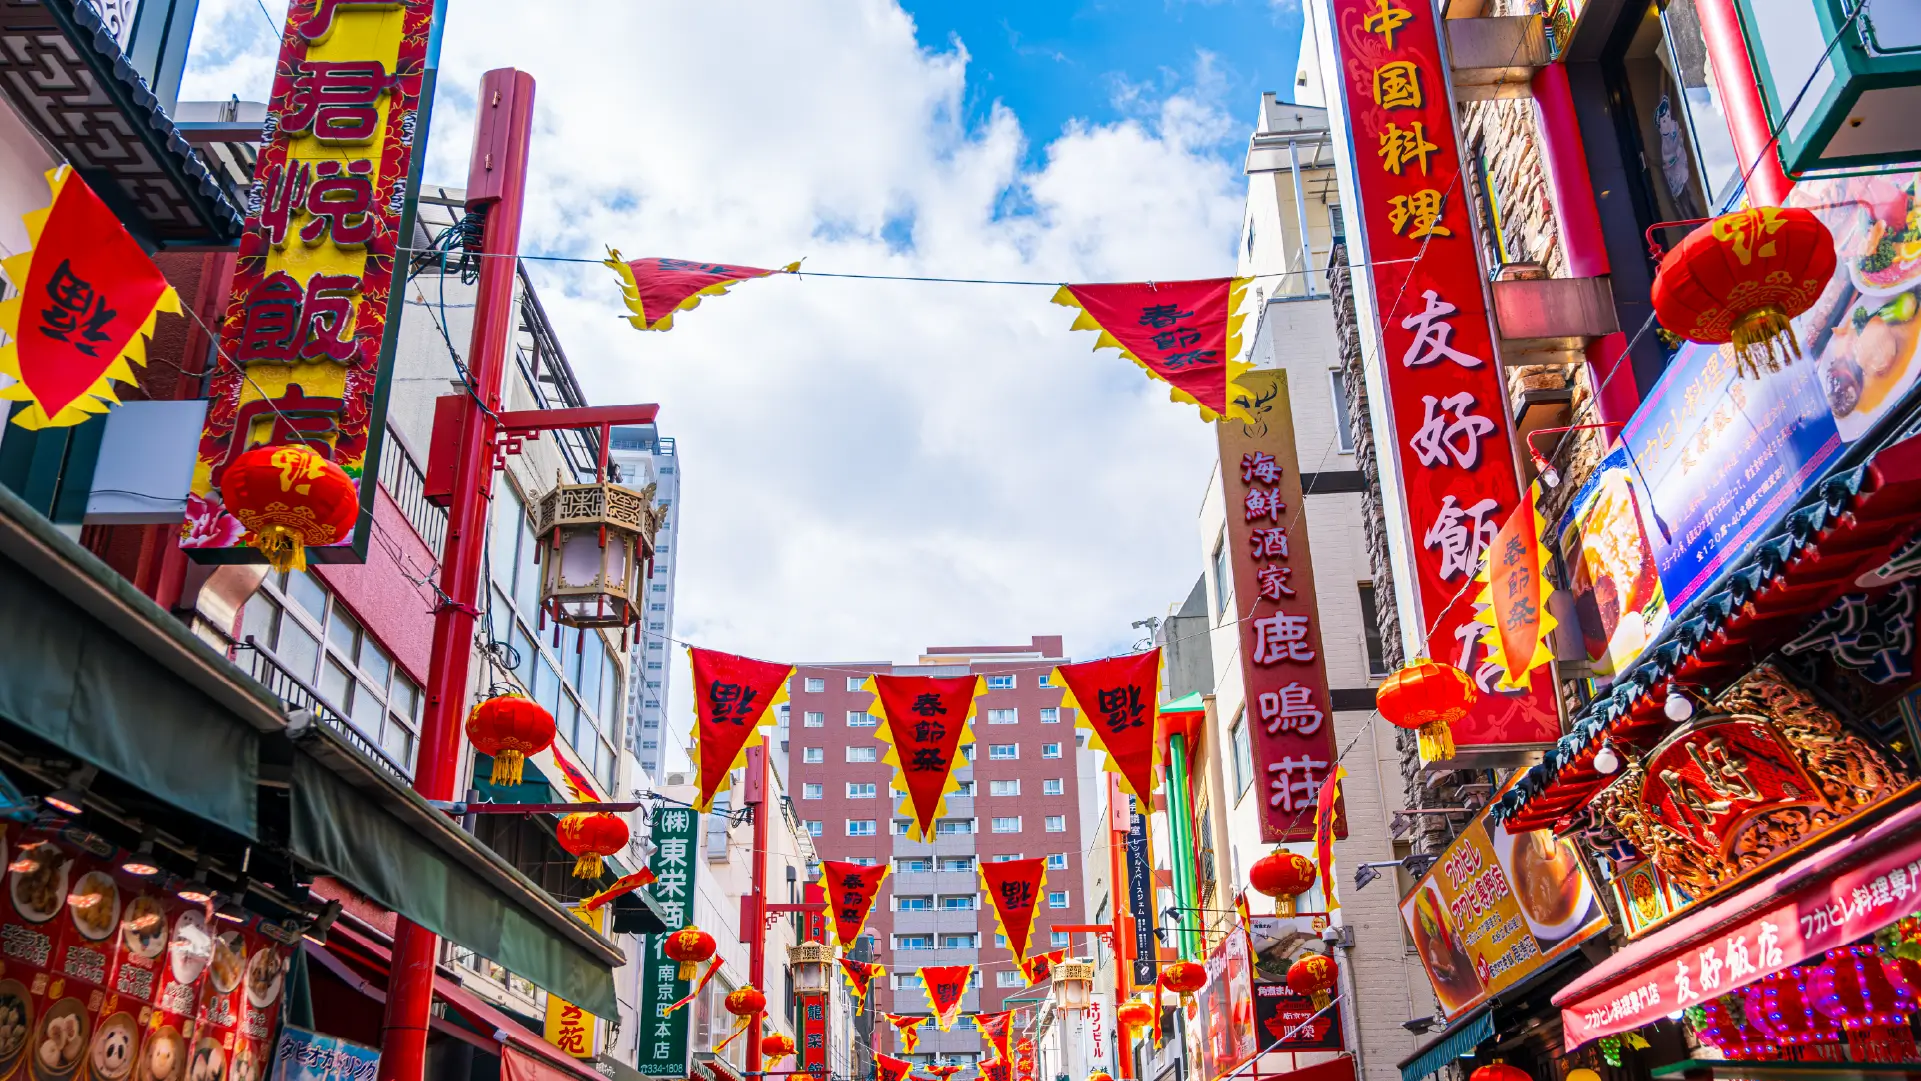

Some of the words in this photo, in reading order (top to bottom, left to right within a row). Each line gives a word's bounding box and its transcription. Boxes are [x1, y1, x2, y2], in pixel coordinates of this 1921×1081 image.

[1364, 0, 1451, 240] 中国料理
[210, 0, 400, 488] 君悦飯店
[1138, 303, 1219, 371] 春節祭
[1239, 451, 1298, 600] 海鮮酒家
[1504, 534, 1537, 631] 春節祭
[912, 692, 947, 773] 春節祭
[1252, 610, 1330, 813] 鹿鳴荘
[839, 873, 866, 924] 春節祭
[1444, 838, 1483, 891] フカヒレ
[813, 915, 821, 943] 中国
[1674, 920, 1784, 1006] 友好飯店
[653, 964, 675, 1060] 南京町本店
[1091, 1002, 1104, 1058] キリンビール
[1583, 981, 1661, 1030] フカヒレ料理専門店
